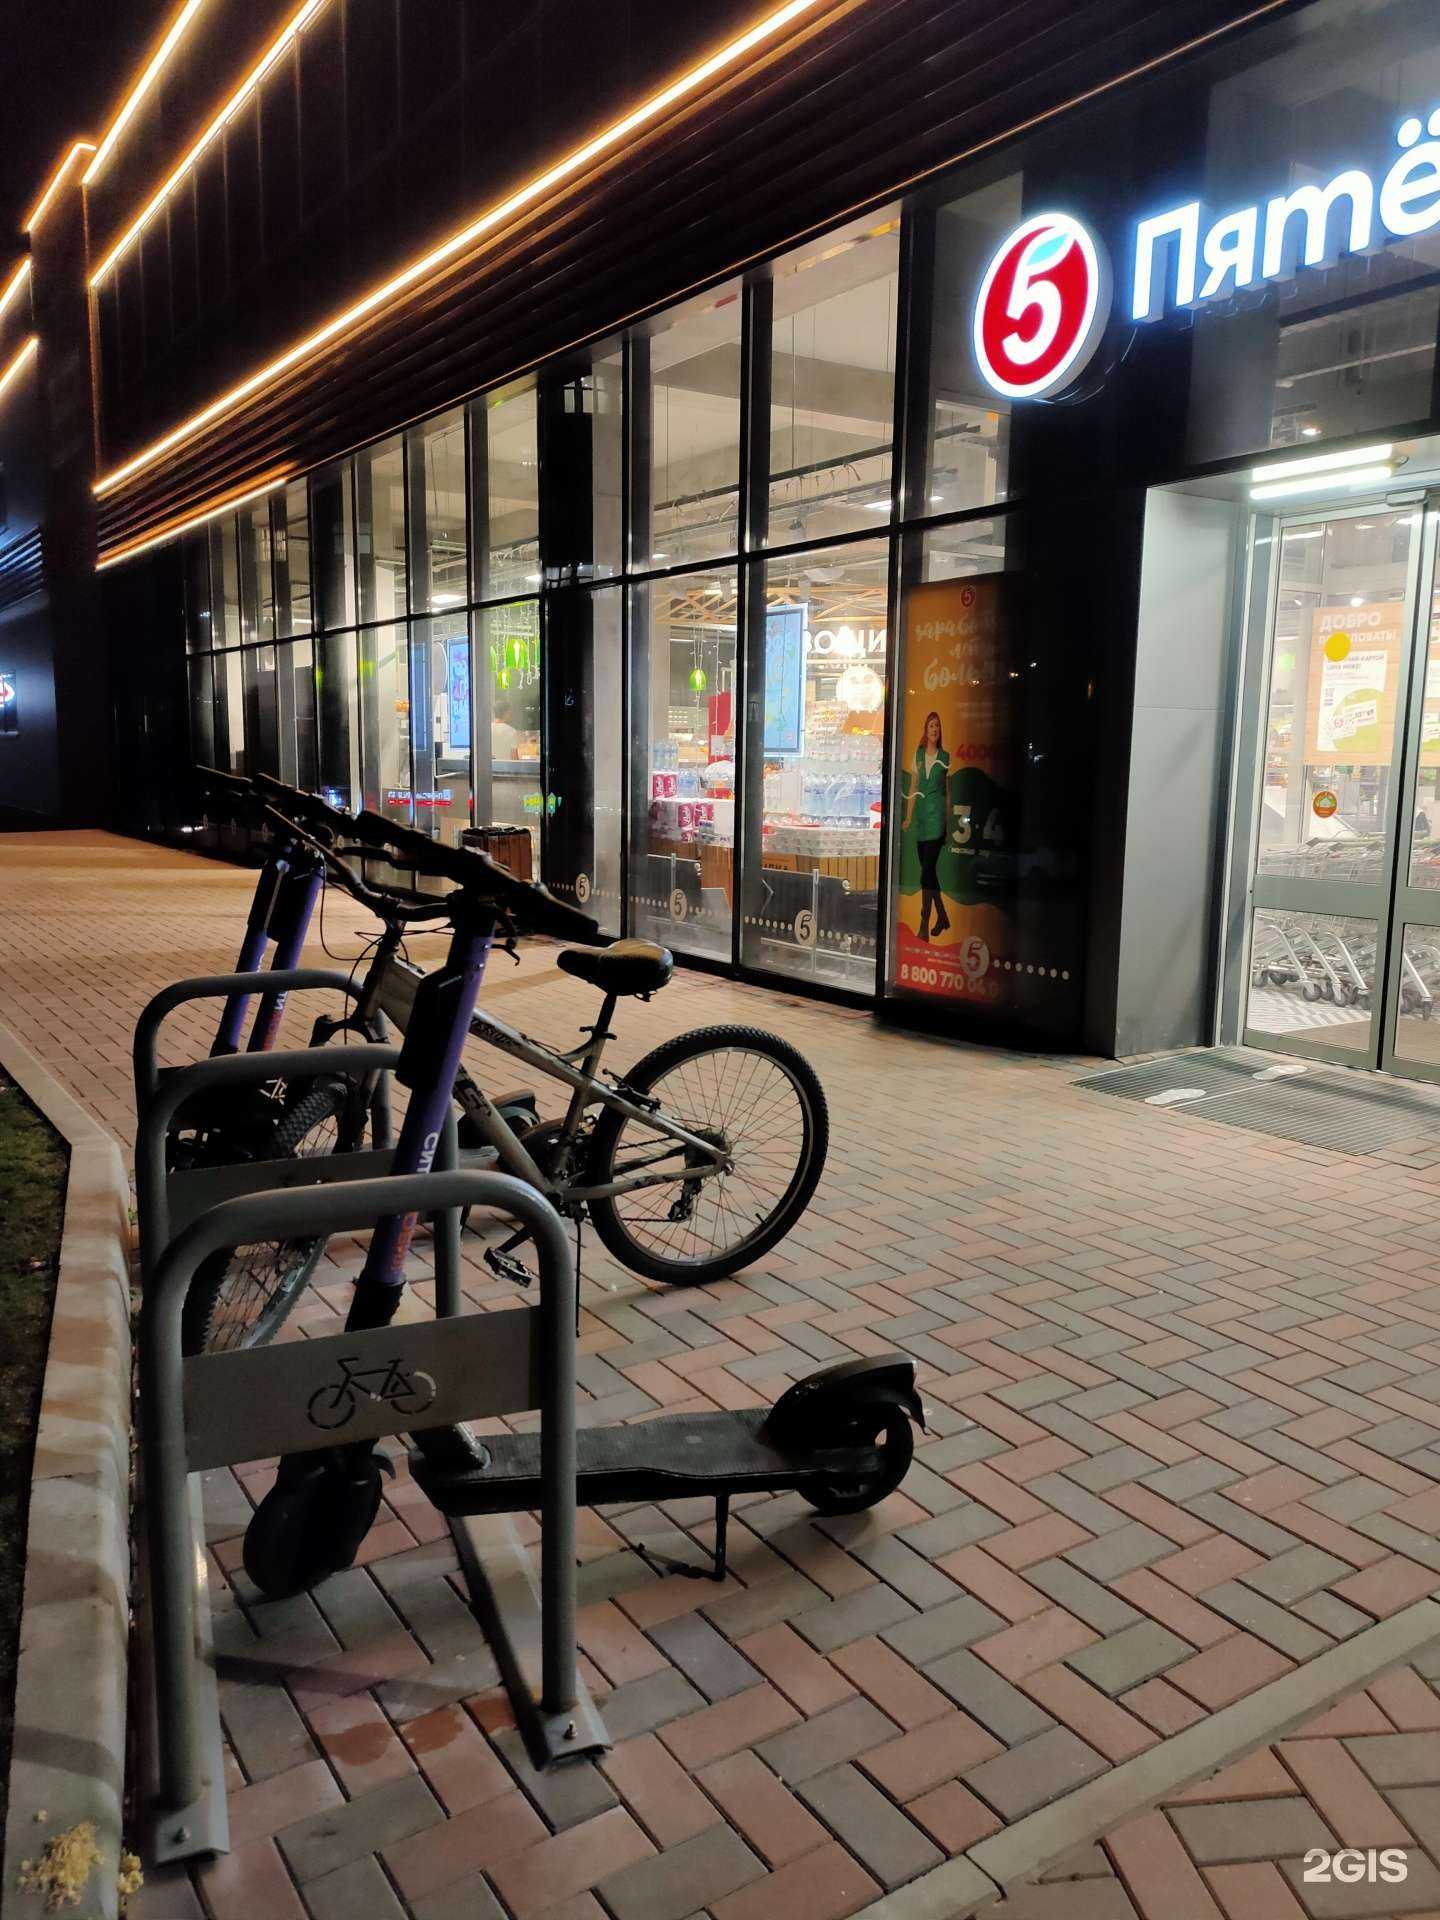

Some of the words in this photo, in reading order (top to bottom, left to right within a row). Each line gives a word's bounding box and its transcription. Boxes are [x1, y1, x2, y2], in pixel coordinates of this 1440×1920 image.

[1132, 109, 1440, 320] Пятё
[1001, 225, 1077, 366] 5
[1318, 629, 1397, 644] ПЛОВАТЬ!
[1320, 613, 1381, 632] ДОБРО
[900, 962, 909, 980] 8
[910, 965, 938, 986] 800
[938, 970, 964, 991] 770
[416, 1131, 440, 1175] СИТ
